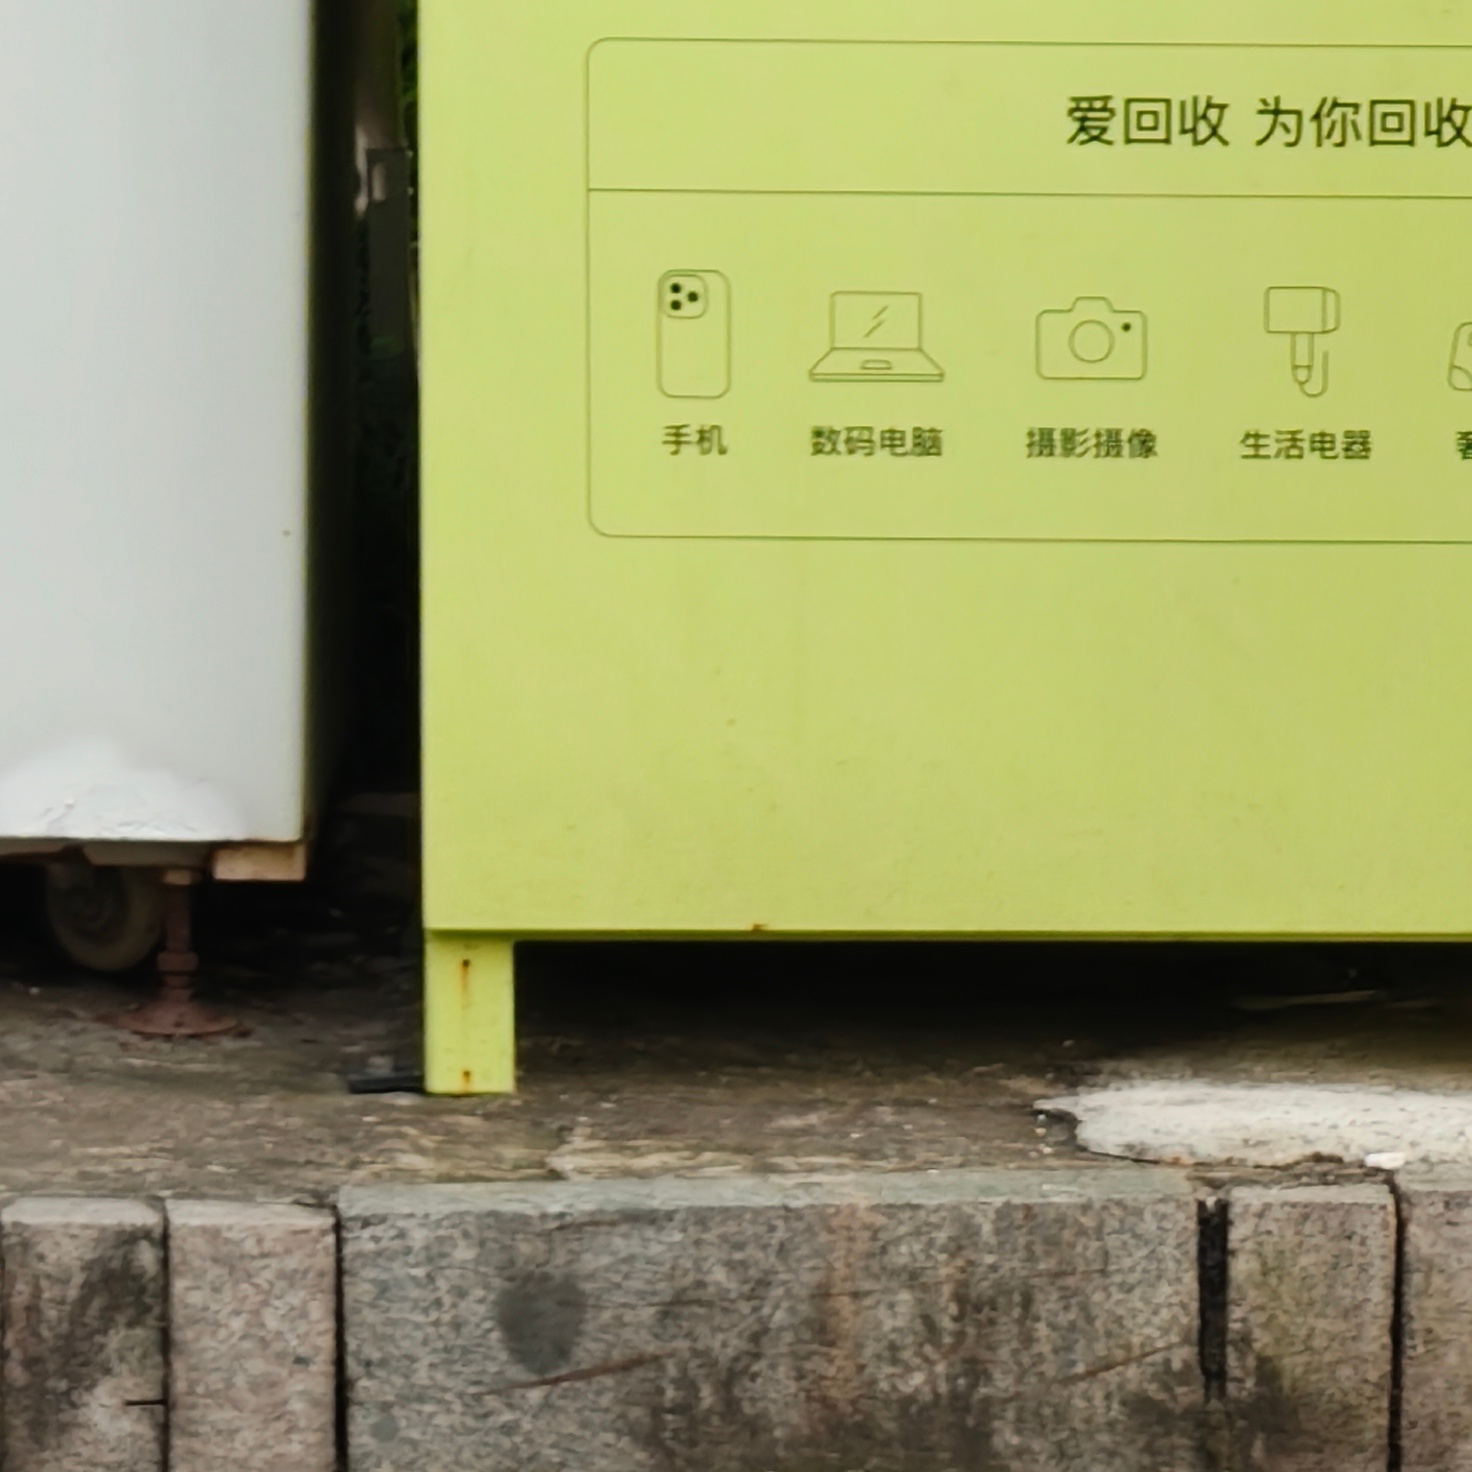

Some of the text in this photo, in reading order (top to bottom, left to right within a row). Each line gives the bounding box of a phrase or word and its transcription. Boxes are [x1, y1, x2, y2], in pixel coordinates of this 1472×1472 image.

[1068, 95, 1229, 146] 爱回收
[663, 424, 727, 455] 手机
[812, 427, 942, 457] 数码电脑
[1027, 428, 1157, 458] 摄影摄像
[1241, 430, 1371, 459] 生活电器
